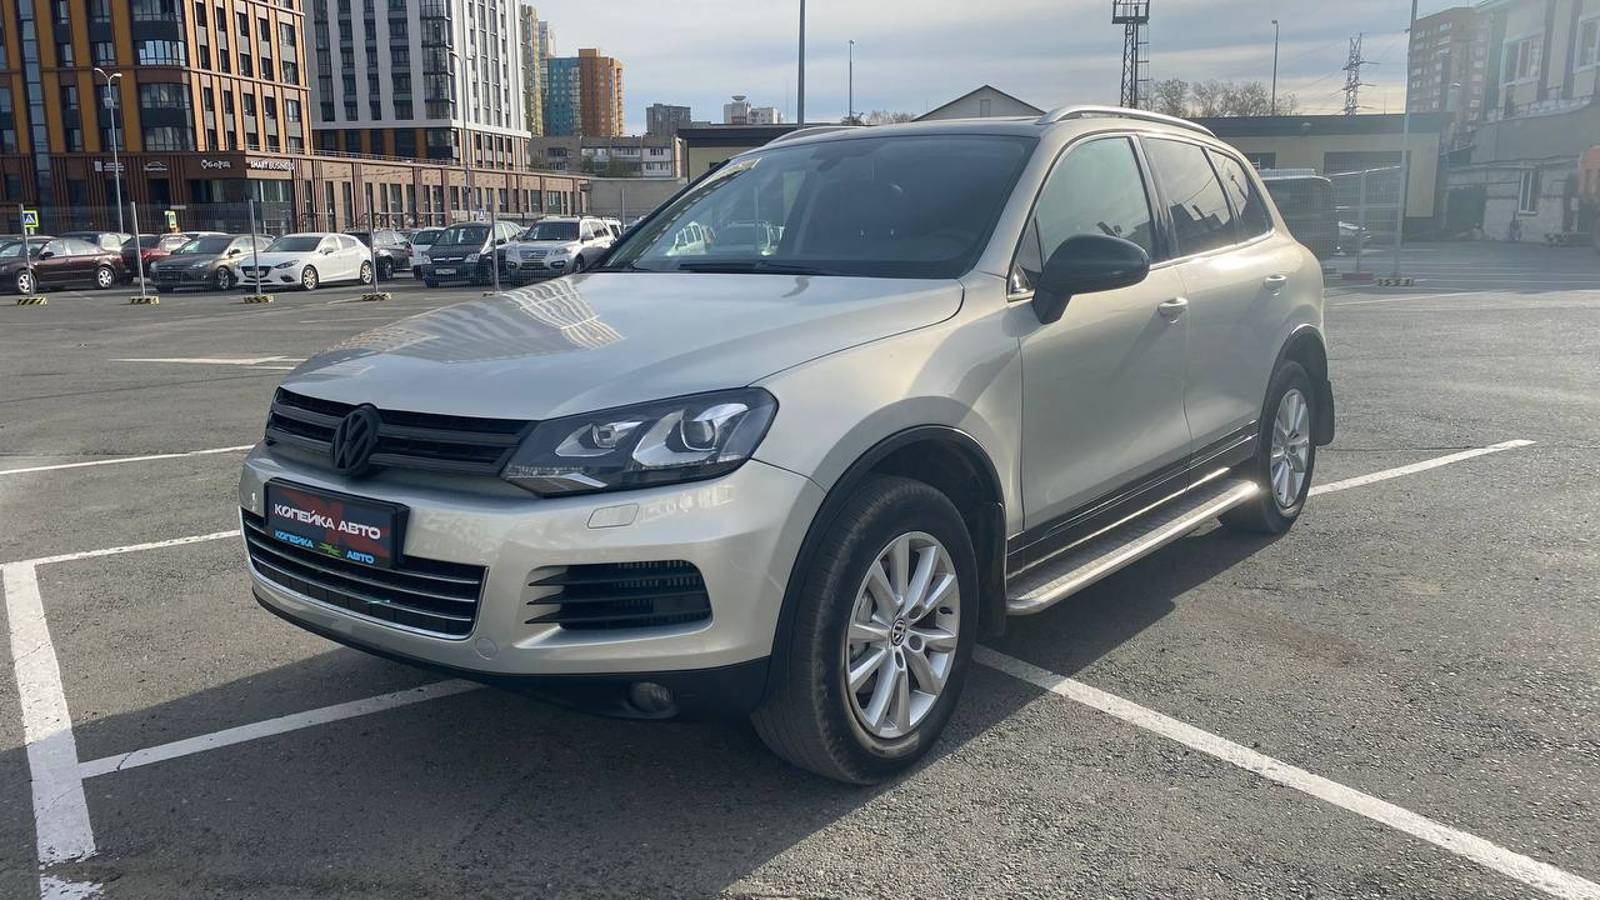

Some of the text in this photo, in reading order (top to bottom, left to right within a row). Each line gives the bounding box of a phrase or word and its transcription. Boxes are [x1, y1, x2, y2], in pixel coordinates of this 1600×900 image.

[250, 159, 295, 171] SMART BUSINESS
[274, 503, 381, 540] КОПЕЙКА АВТО
[274, 530, 375, 565] КОПЕЙКА АВТО
